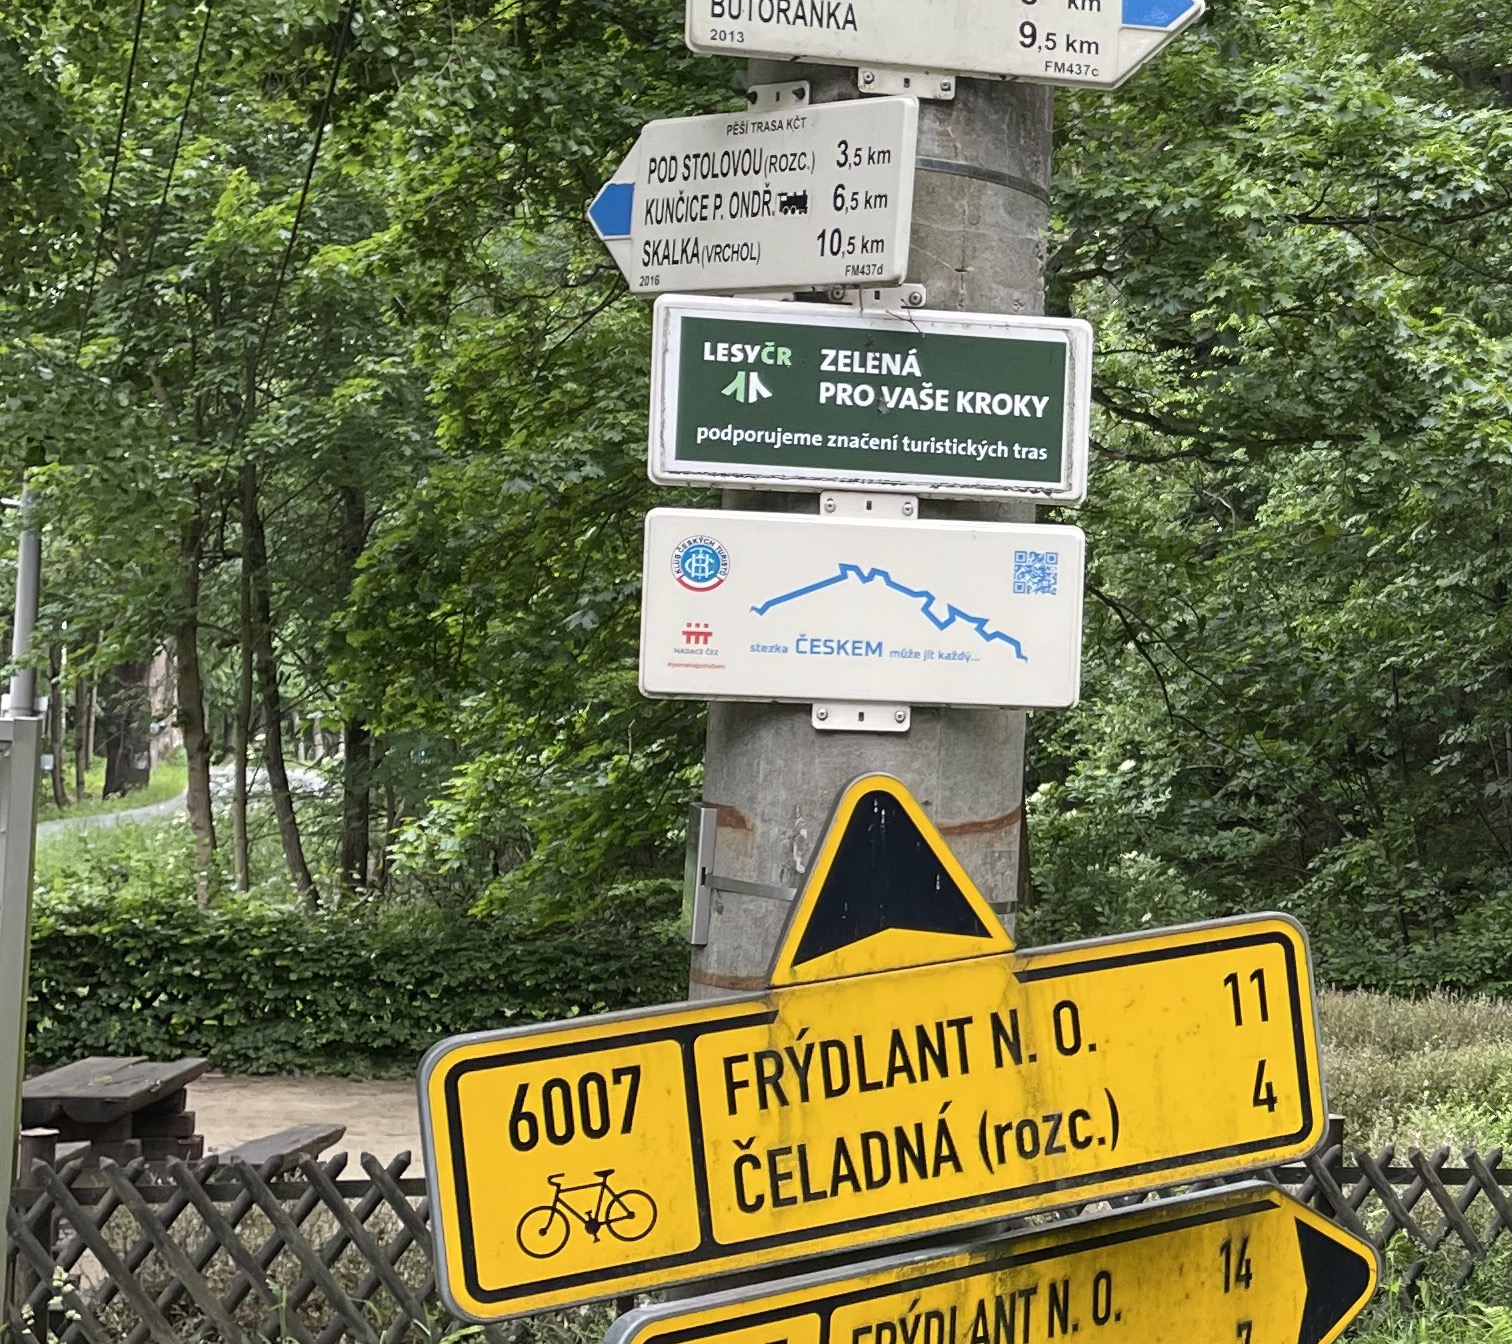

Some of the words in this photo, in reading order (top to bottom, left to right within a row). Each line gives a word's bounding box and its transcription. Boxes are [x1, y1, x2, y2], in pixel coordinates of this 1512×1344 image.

[710, 29, 744, 42] 2013
[1019, 21, 1056, 52] 9,5
[1066, 34, 1098, 54] km
[1045, 61, 1098, 76] FM437c
[727, 121, 748, 136] PĚŠÍ
[751, 120, 783, 133] TRASA
[786, 115, 806, 130] KČT
[648, 156, 677, 184] POD
[682, 148, 762, 181] STOLOVOU
[837, 140, 862, 169] 3,5
[868, 146, 890, 165] km
[645, 190, 709, 225] KUNČICE
[713, 194, 723, 220] P.
[729, 183, 775, 219] ONDŘ.
[833, 184, 859, 213] 6,5
[864, 191, 887, 209] km
[642, 237, 699, 267] SKALKA
[817, 228, 855, 257] 10,5
[861, 236, 884, 254] km
[639, 275, 659, 286] 2016
[845, 264, 883, 276] FM437d
[820, 349, 921, 377] ZELENÁ
[820, 382, 874, 406] PRO
[881, 382, 949, 411] VAŠE
[957, 391, 1049, 417] KROKY
[697, 424, 822, 448] podporujeme
[827, 433, 898, 450] značení
[902, 436, 1008, 460] turistických
[1013, 443, 1047, 460] tras
[750, 643, 788, 653] stezka
[796, 634, 883, 657] ČESKEM
[723, 1016, 973, 1116] FRÝDLANT
[990, 1009, 1037, 1068] N.
[1053, 1000, 1096, 1056] O.
[1224, 968, 1268, 1026] 11
[509, 1065, 641, 1151] 6007
[733, 1100, 963, 1213] ČELADNÁ
[979, 1088, 1119, 1174] (rozc.)
[1253, 1059, 1277, 1112] 4
[1047, 1281, 1079, 1338] N.
[1093, 1269, 1121, 1326] O.
[1219, 1236, 1253, 1294] 14
